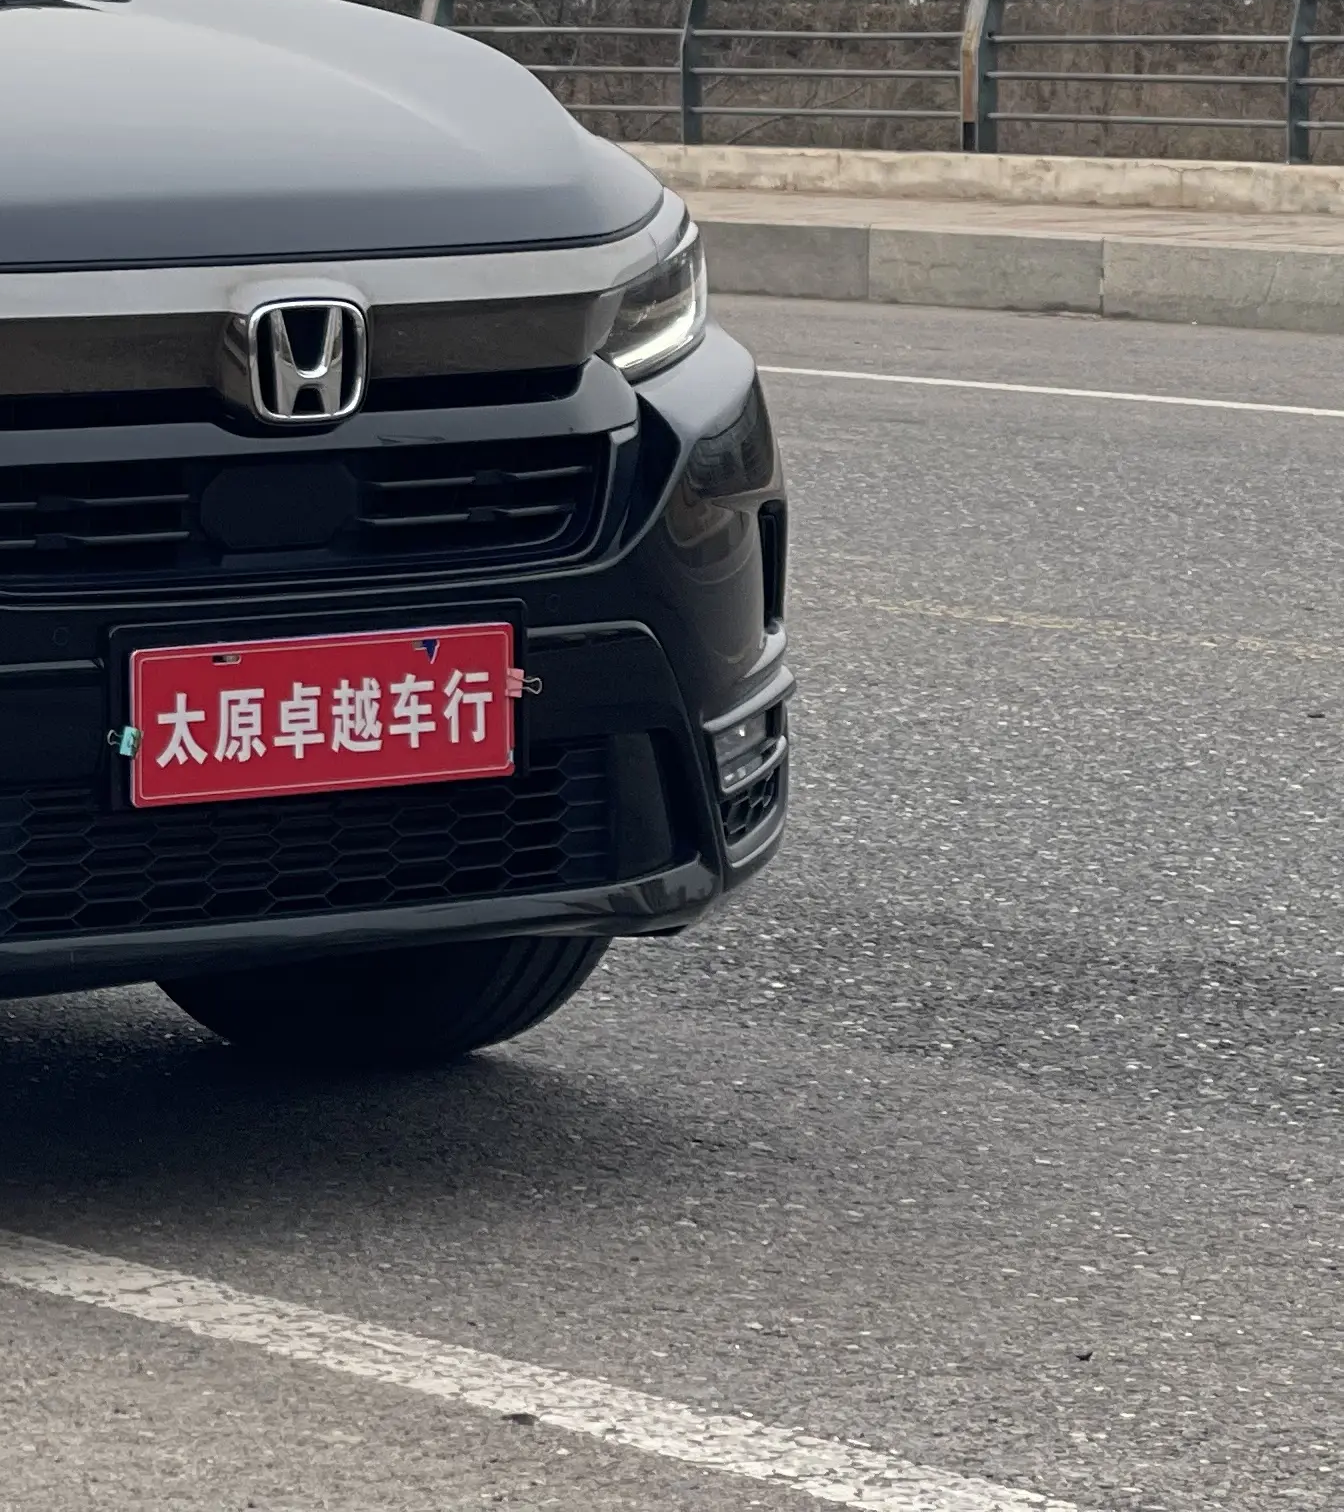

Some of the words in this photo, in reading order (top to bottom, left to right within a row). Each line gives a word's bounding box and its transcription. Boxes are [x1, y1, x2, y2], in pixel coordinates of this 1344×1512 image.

[155, 668, 493, 769] 太原卓越车行
